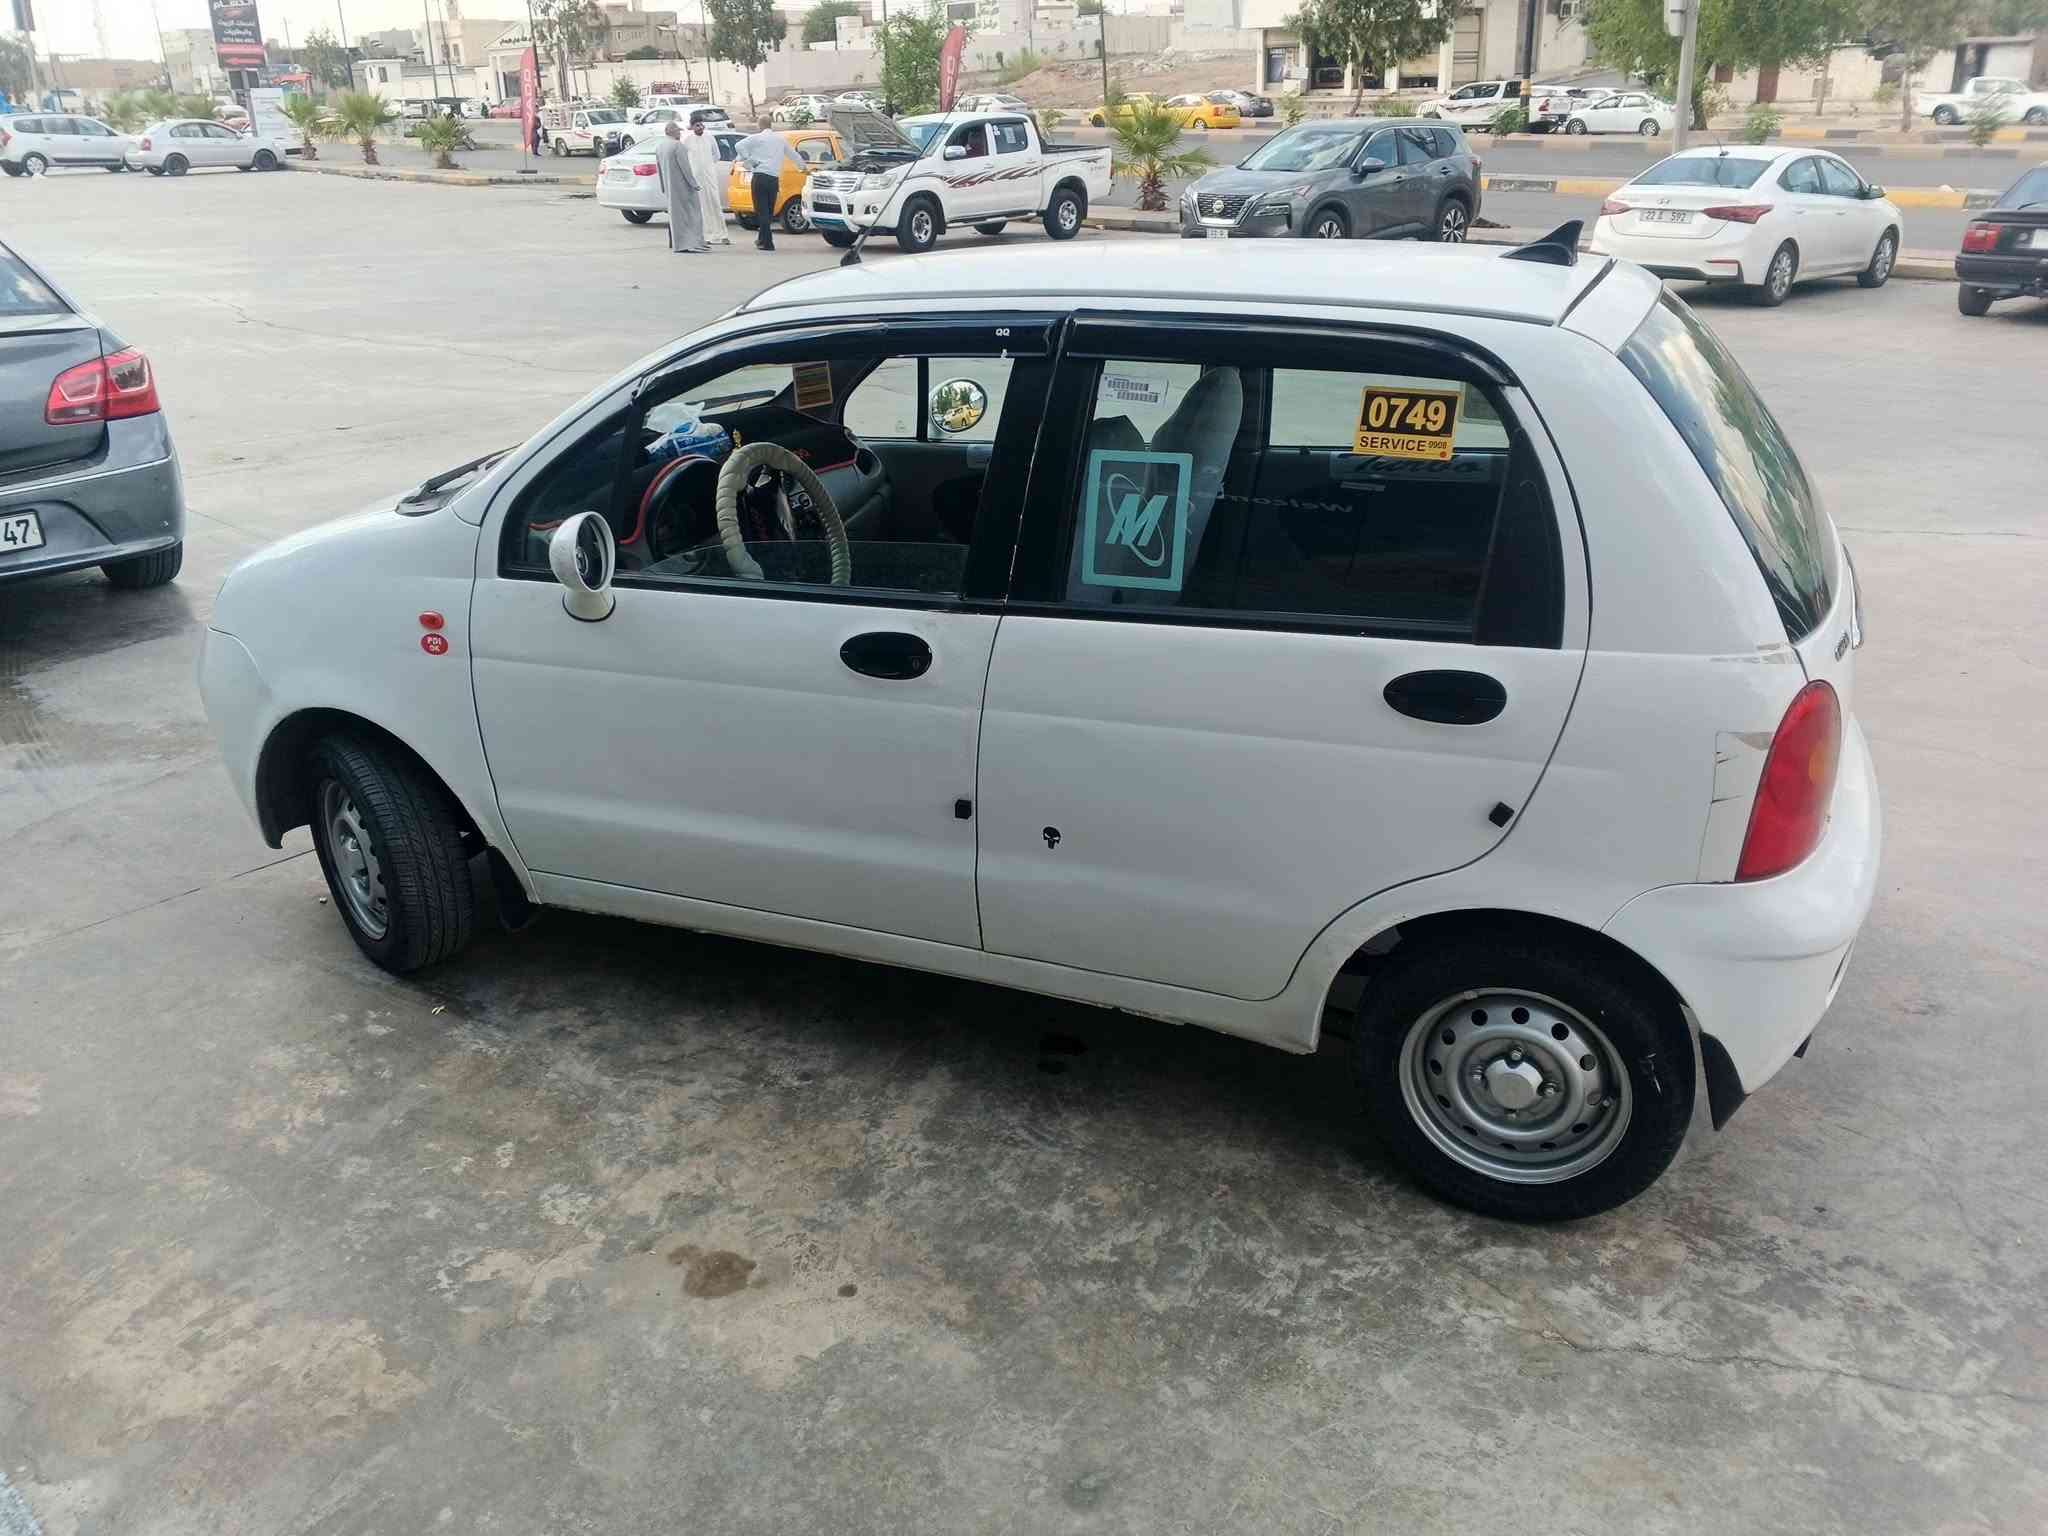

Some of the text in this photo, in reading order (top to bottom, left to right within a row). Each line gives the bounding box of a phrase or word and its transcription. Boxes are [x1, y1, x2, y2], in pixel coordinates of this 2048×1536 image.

[1368, 396, 1447, 432] 0749
[1359, 435, 1427, 452] SERVICE
[4, 519, 29, 545] 47
